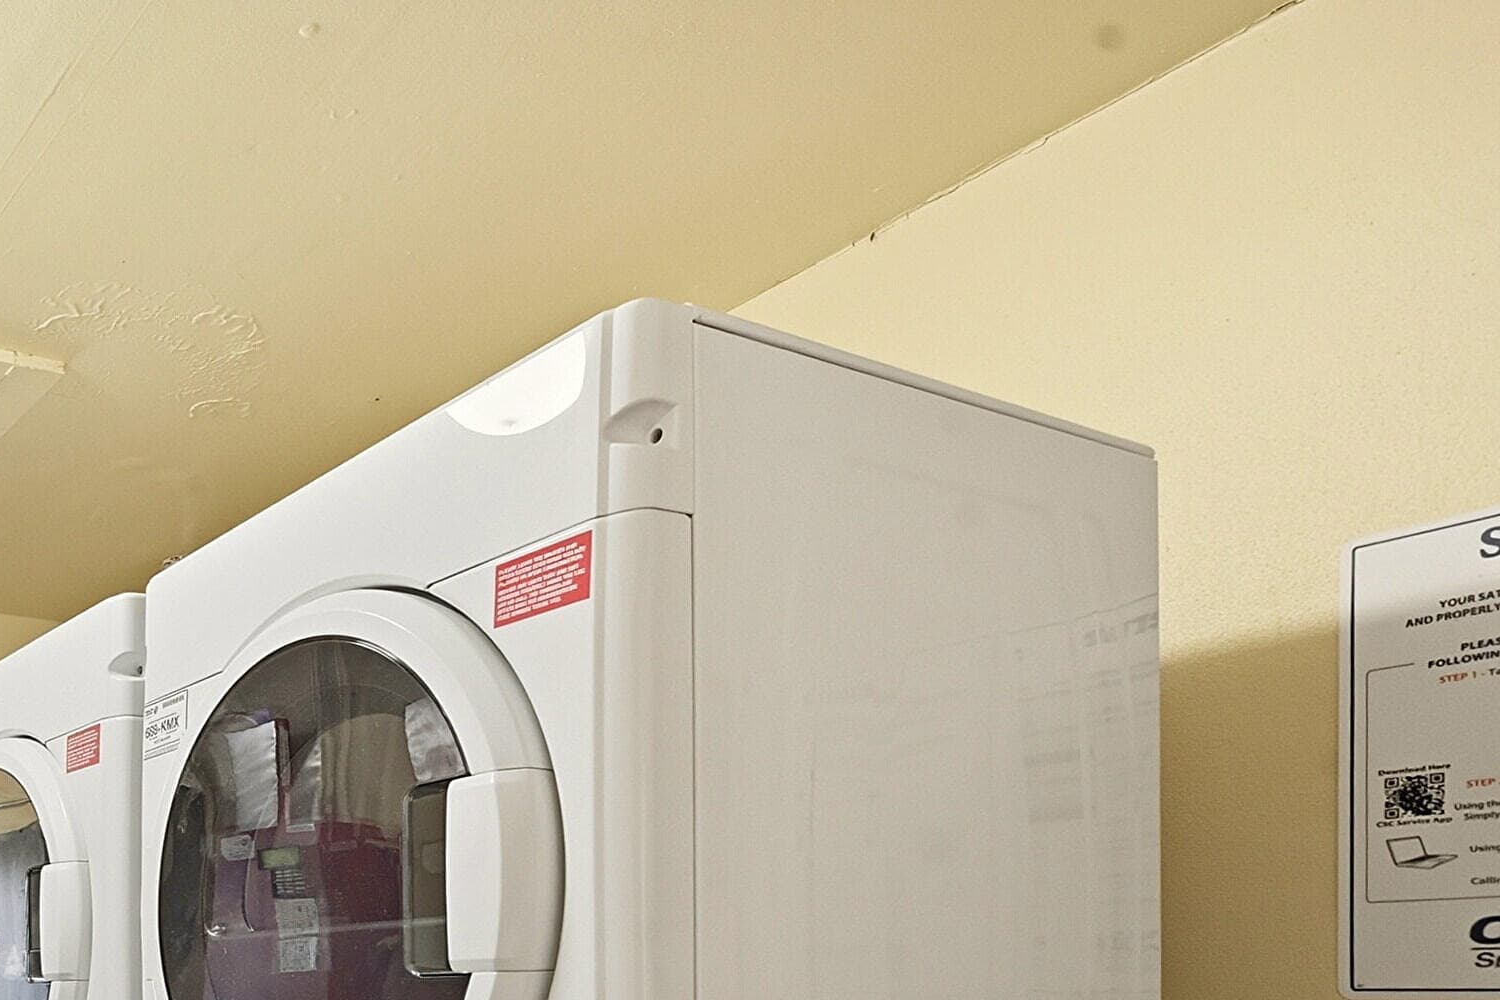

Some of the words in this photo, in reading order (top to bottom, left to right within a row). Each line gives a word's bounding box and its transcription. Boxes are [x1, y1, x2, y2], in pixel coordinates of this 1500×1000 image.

[1439, 594, 1475, 608] YOUR
[1405, 615, 1434, 628] AND
[1436, 603, 1500, 622] PROPERLY
[1428, 650, 1500, 668] FOLLOWIN
[1439, 671, 1468, 684] STEP
[1454, 802, 1485, 811] Using
